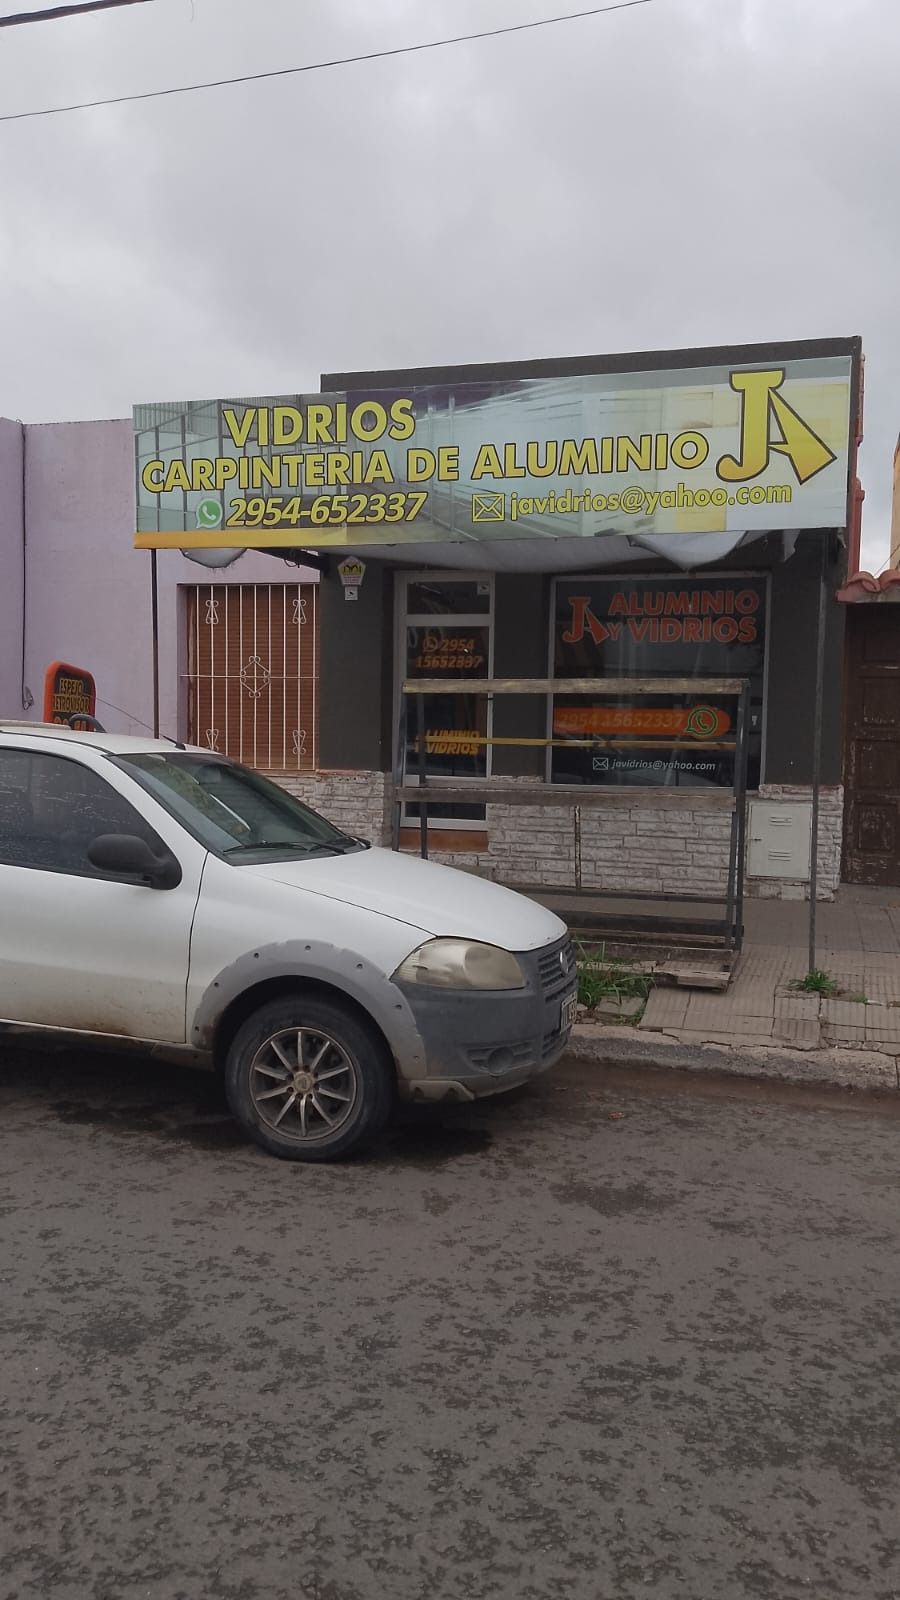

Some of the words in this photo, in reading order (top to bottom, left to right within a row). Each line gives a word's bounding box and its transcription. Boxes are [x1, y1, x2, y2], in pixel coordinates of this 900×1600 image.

[224, 398, 415, 448] VIDRIOS
[715, 367, 838, 485] JA
[142, 450, 394, 493] CARPINTERIA
[406, 446, 460, 483] DE
[471, 431, 709, 480] ALUMINIO
[226, 492, 428, 527] 2954-652337
[511, 483, 792, 521] javidrios@yahoo.com
[608, 590, 759, 615] ALUMINIO
[440, 639, 474, 654] 2954
[627, 617, 757, 643] VIDRIOS
[611, 759, 716, 771] javidrios@yahoo.com
